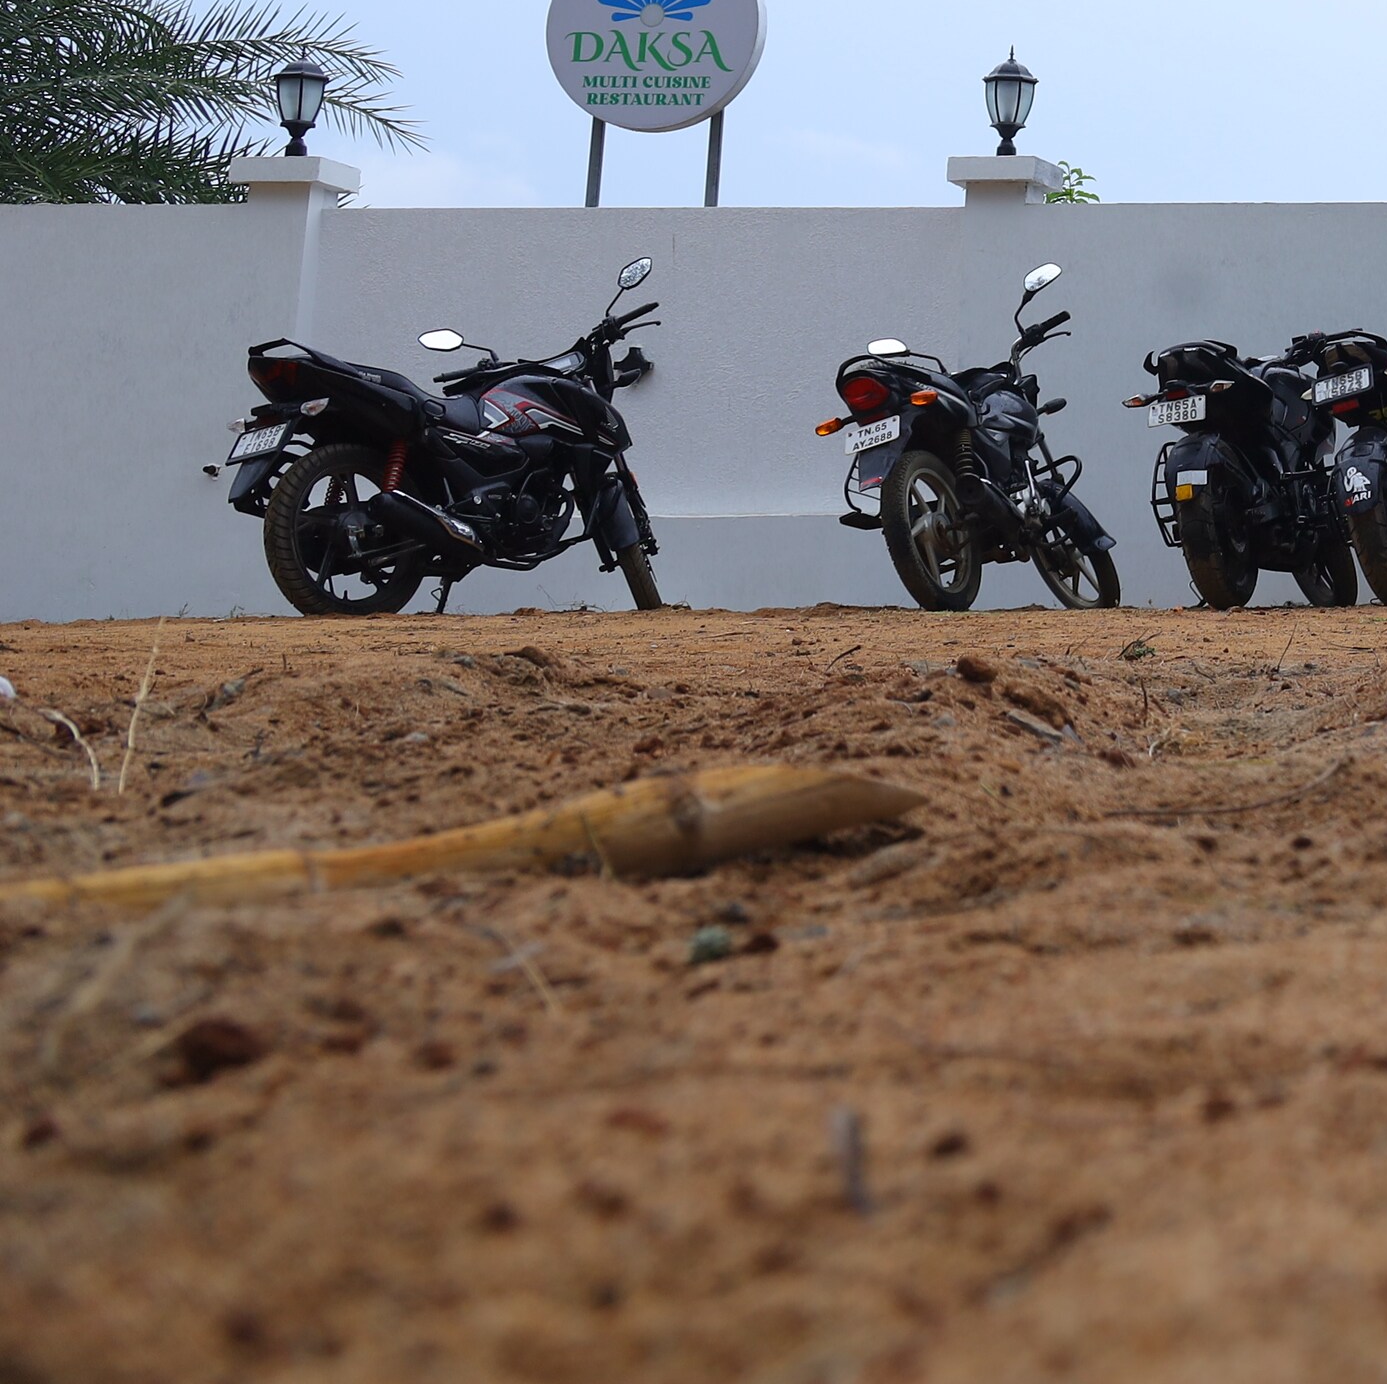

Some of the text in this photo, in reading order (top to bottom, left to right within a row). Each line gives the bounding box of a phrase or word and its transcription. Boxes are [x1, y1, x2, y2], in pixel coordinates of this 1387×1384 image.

[564, 29, 735, 73] DAKSA
[582, 75, 712, 89] MULTI CUISINE
[586, 92, 705, 106] RESTAURANT
[1324, 371, 1362, 389] TN65B
[1160, 398, 1197, 414] TN65A
[1158, 408, 1197, 424] S8380
[857, 421, 888, 438] TN.65
[852, 431, 893, 451] AY.2688
